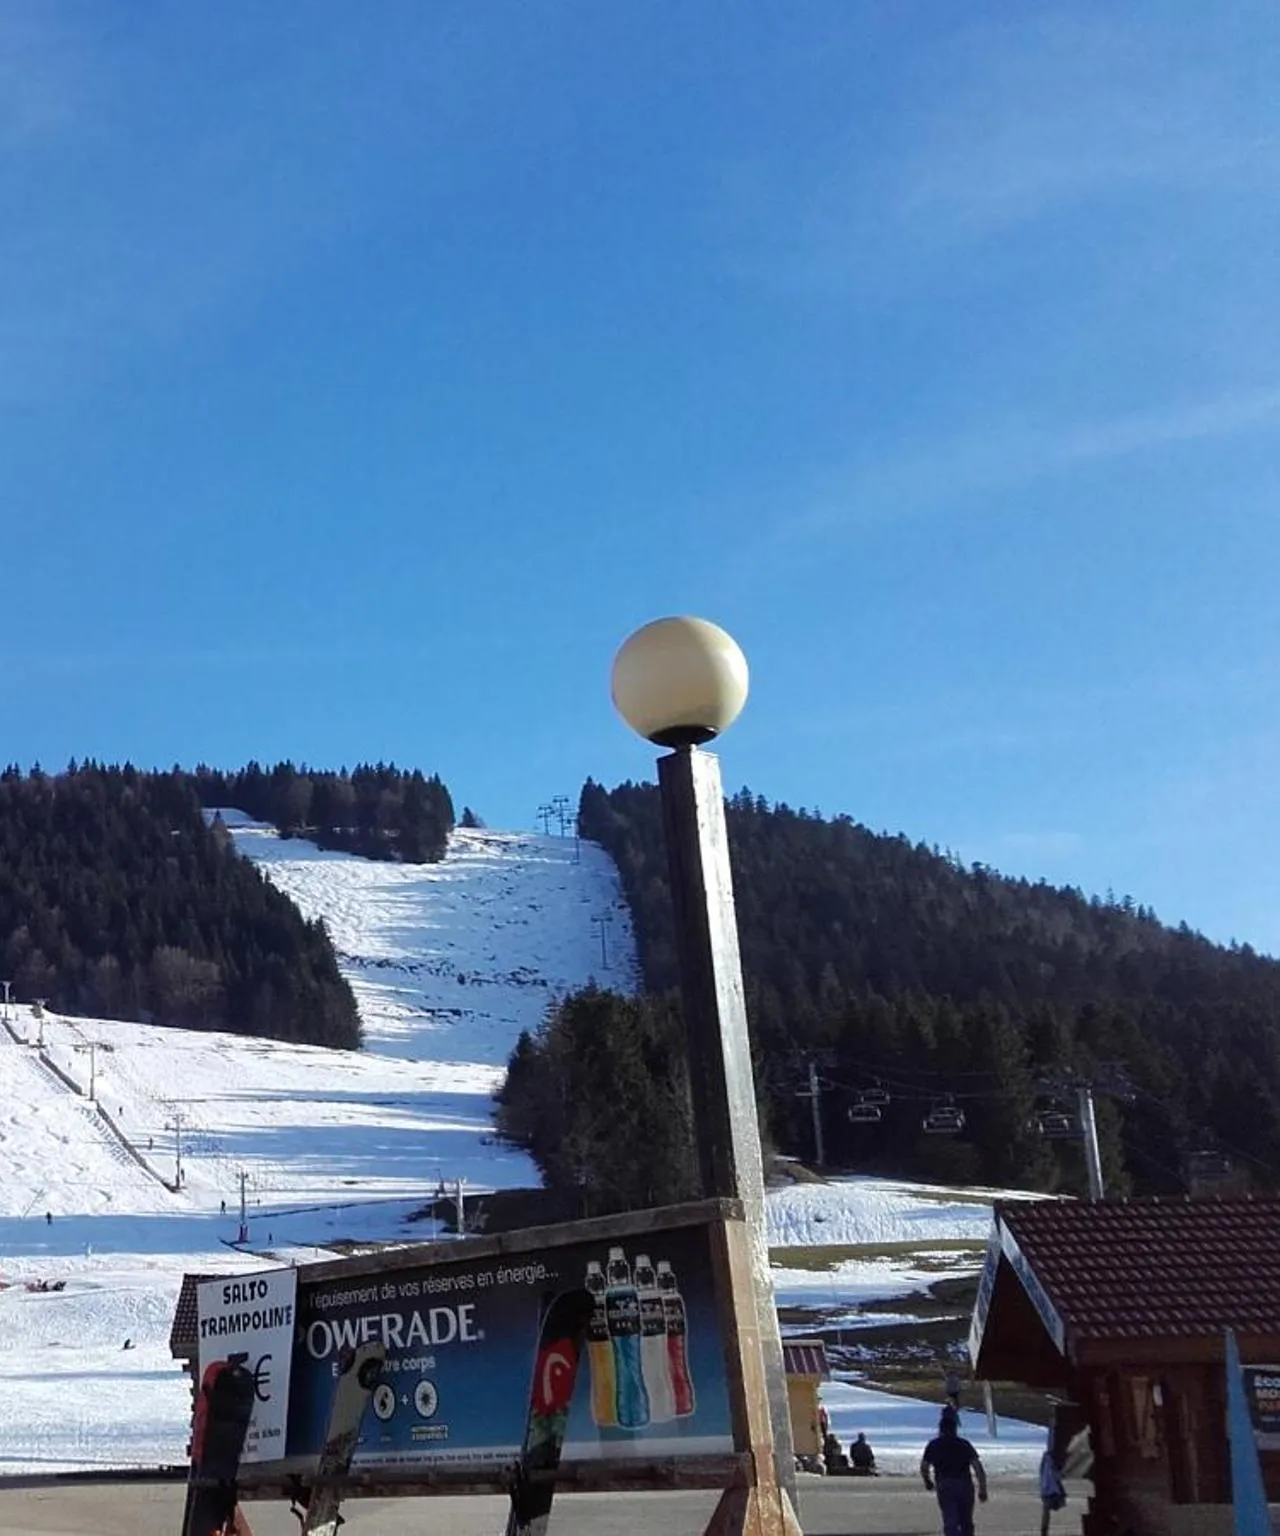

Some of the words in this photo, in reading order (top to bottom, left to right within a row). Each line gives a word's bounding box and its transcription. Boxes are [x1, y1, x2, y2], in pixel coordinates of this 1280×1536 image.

[222, 1279, 269, 1305] SALTO
[381, 1283, 396, 1300] de
[399, 1281, 420, 1298] vos
[422, 1273, 474, 1295] réserves
[477, 1272, 495, 1288] en
[200, 1304, 293, 1339] TRAMPOLINE
[297, 1303, 478, 1360] OWERADE
[401, 1355, 437, 1376] corps
